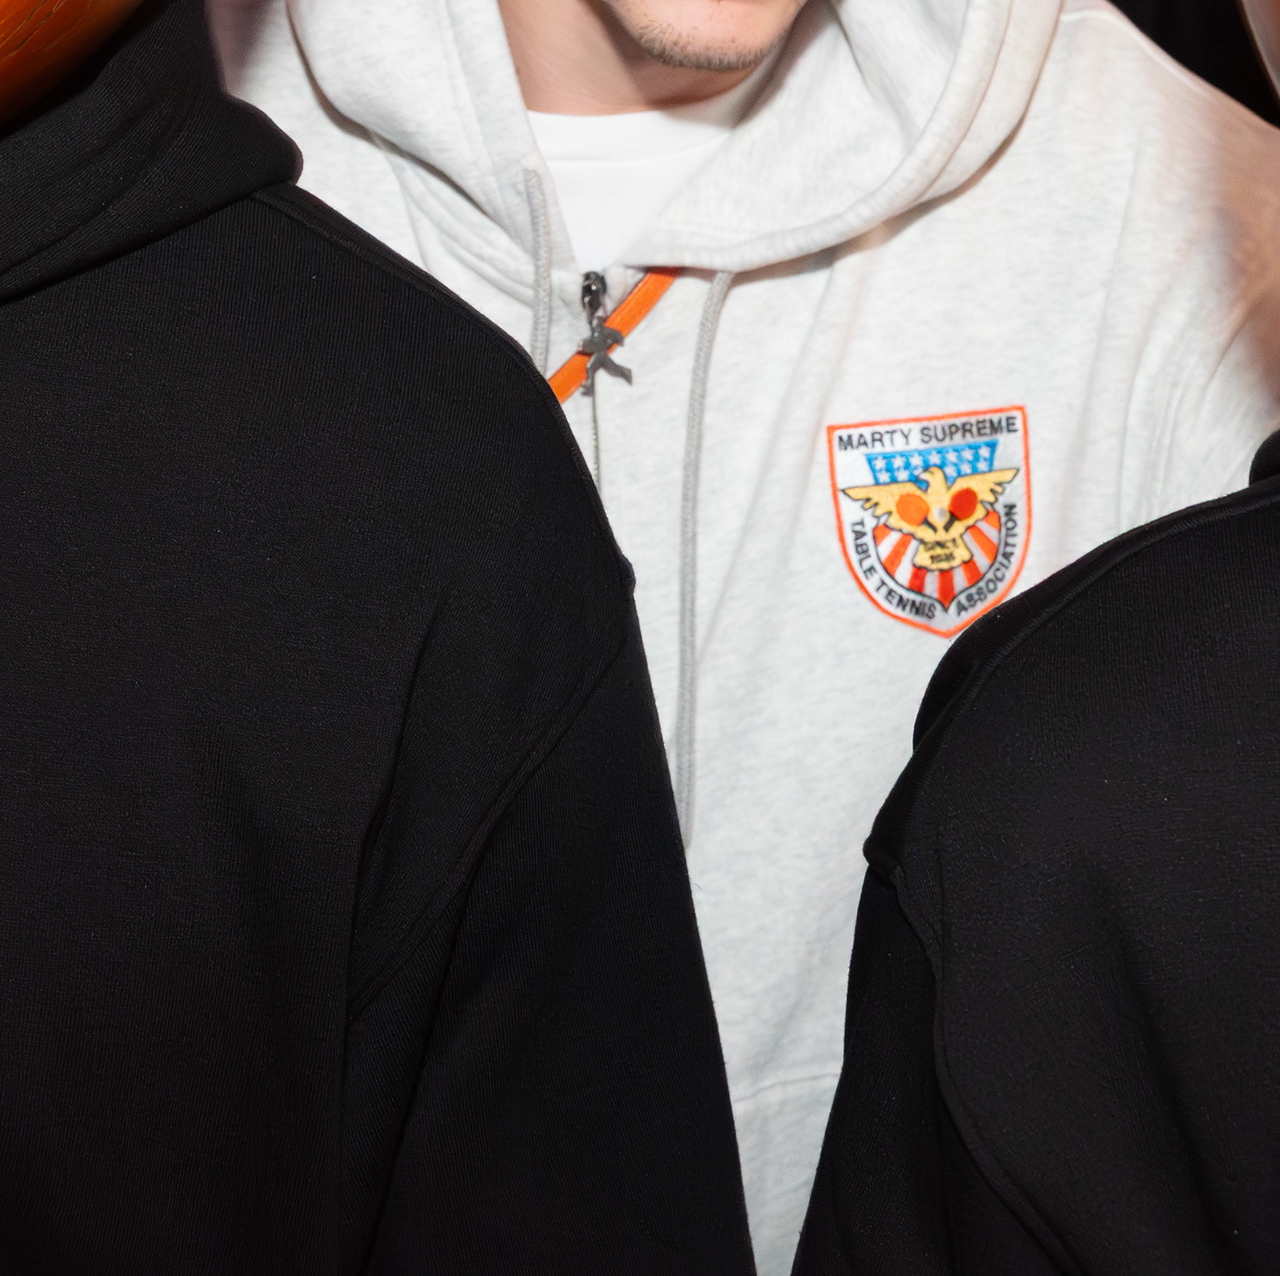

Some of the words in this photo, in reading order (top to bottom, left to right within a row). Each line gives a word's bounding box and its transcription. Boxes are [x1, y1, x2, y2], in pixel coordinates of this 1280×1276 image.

[838, 429, 912, 451] MARTY
[920, 416, 1018, 443] SUPREME
[852, 518, 878, 580] TABLE
[875, 580, 936, 620] TENNIS
[956, 502, 1018, 617] ASSOCIATION
